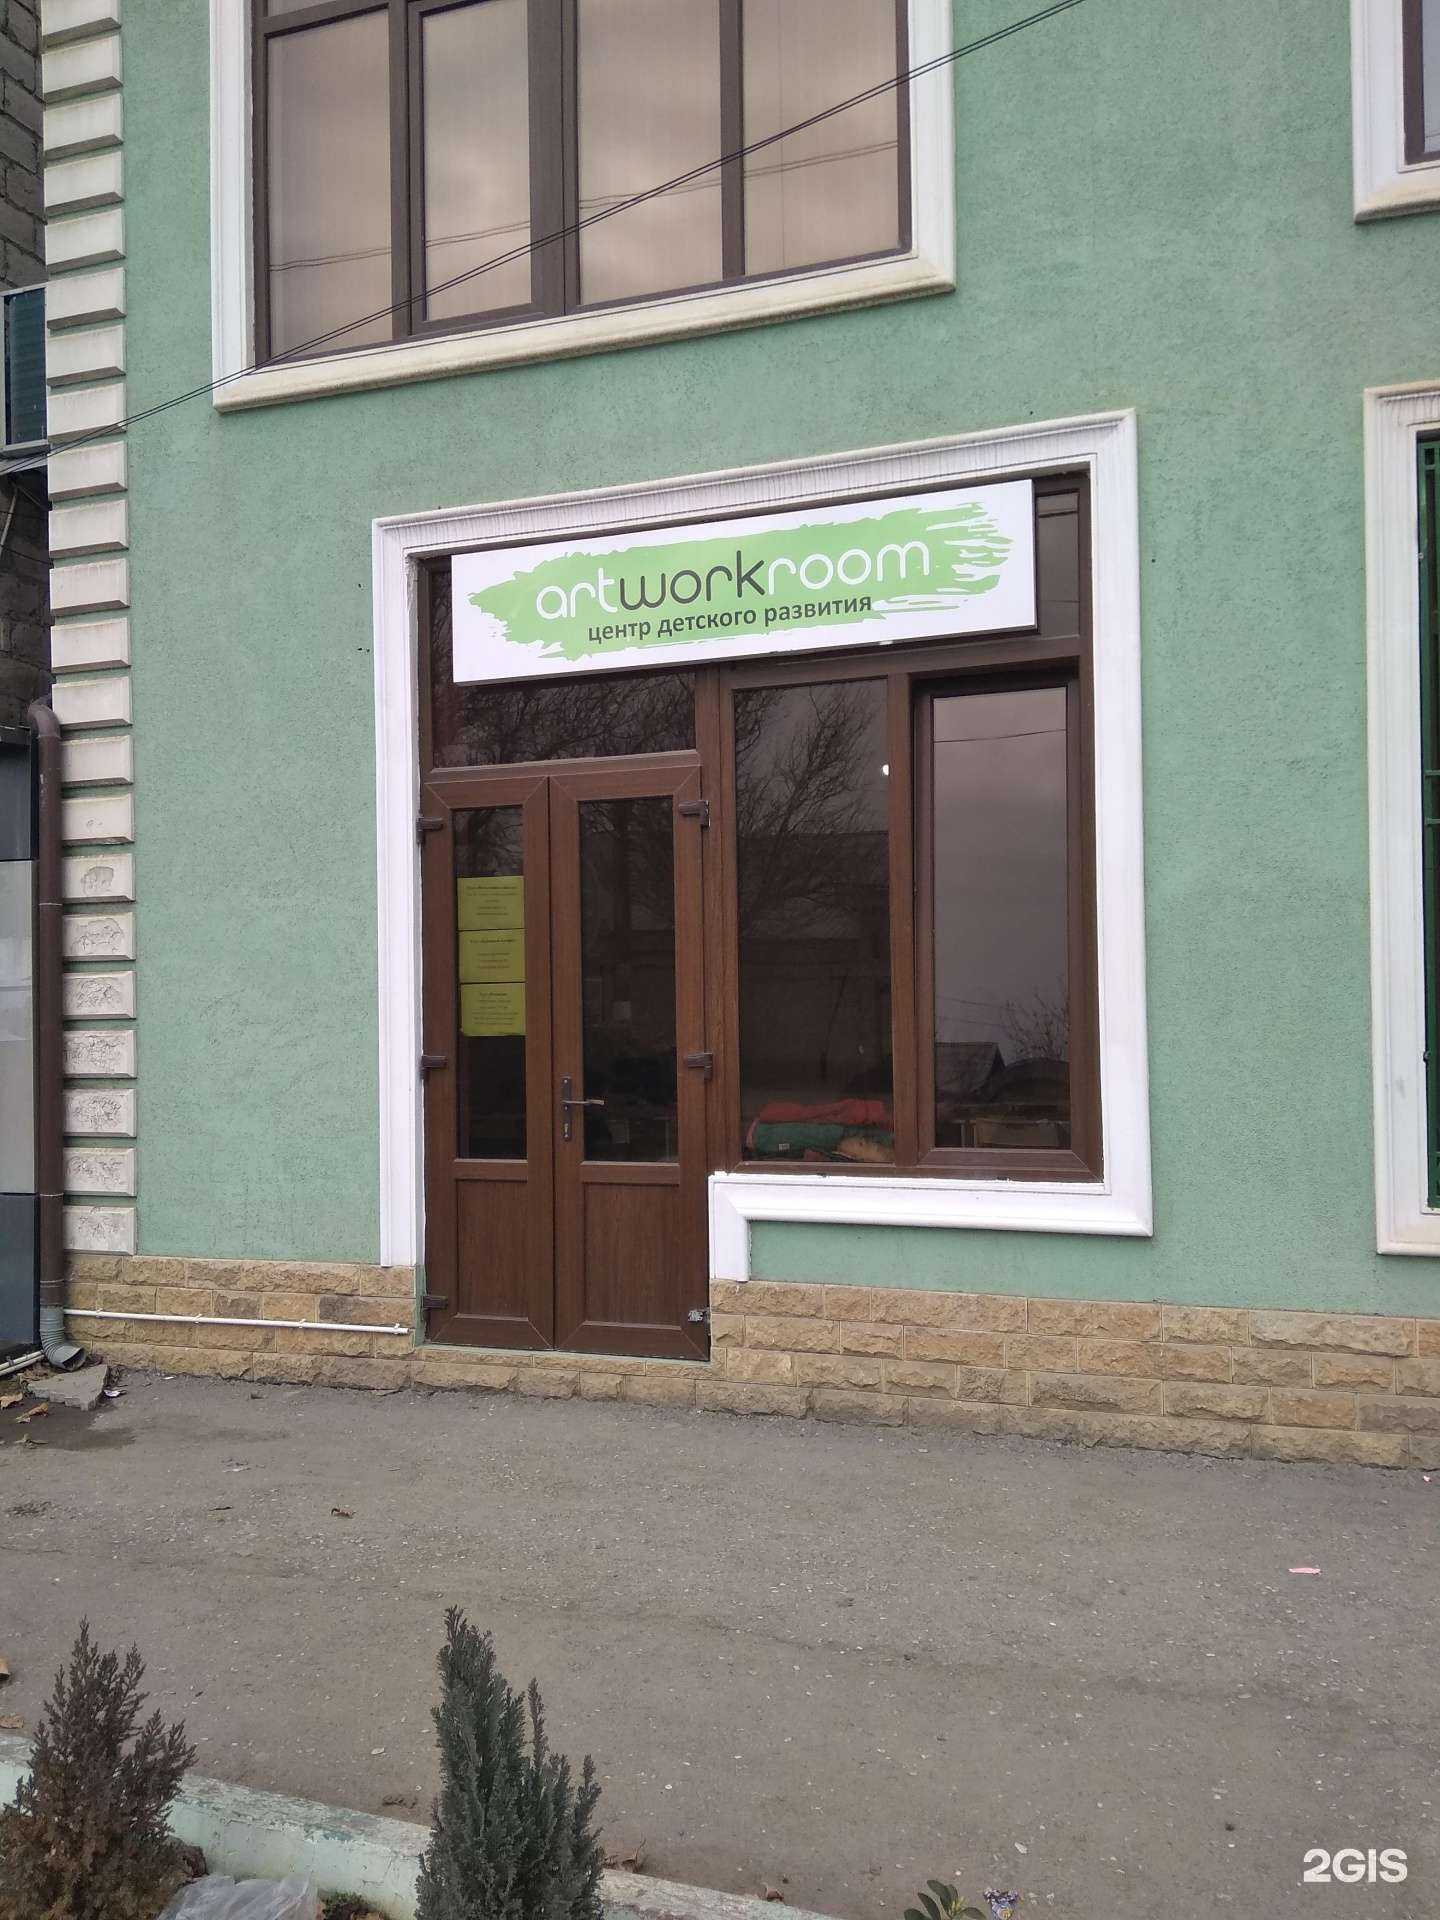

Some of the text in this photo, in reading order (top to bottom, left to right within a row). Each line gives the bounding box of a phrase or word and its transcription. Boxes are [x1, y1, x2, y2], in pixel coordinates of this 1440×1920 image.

[536, 541, 931, 620] artworkroom
[588, 595, 872, 643] центр детского развития
